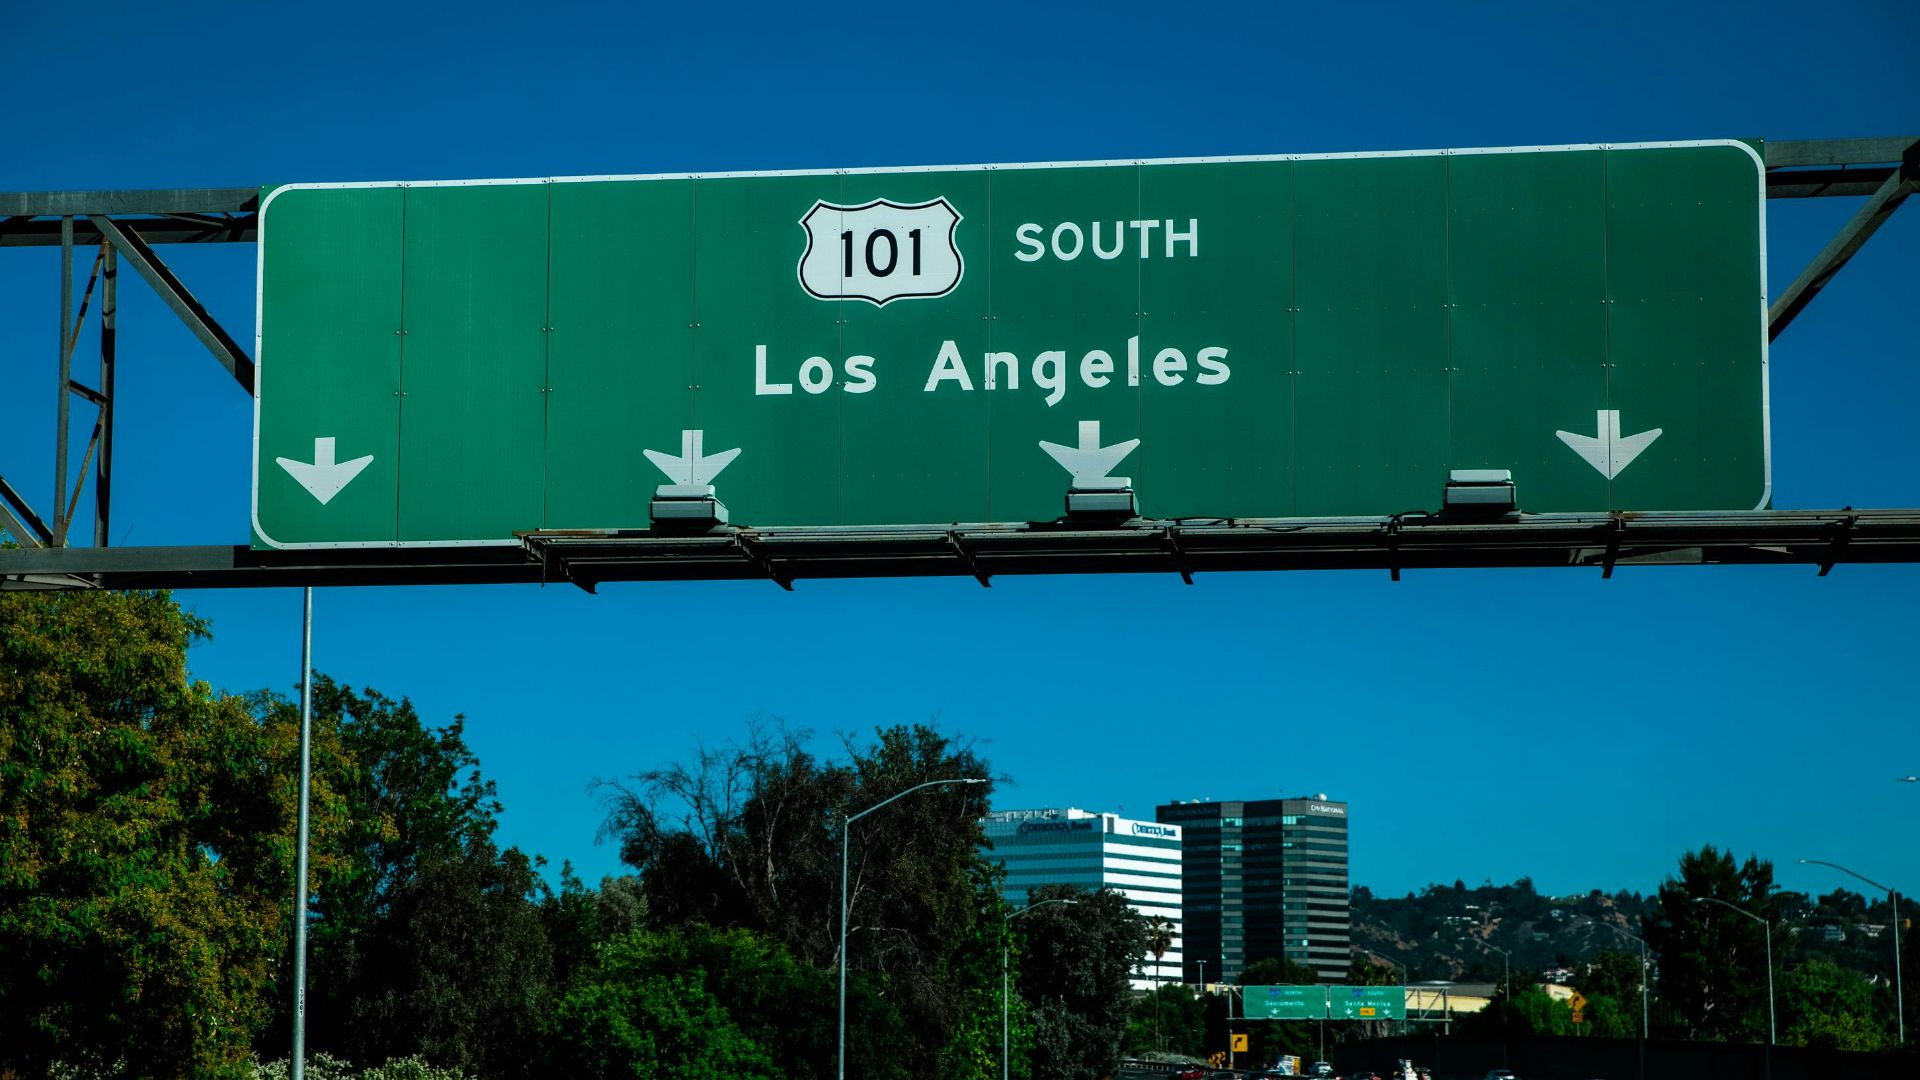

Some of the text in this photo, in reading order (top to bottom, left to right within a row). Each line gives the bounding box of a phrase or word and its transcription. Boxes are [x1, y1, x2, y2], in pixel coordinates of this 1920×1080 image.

[840, 218, 1199, 277] 101 SOUTH
[755, 335, 1231, 407] Los Angeles
